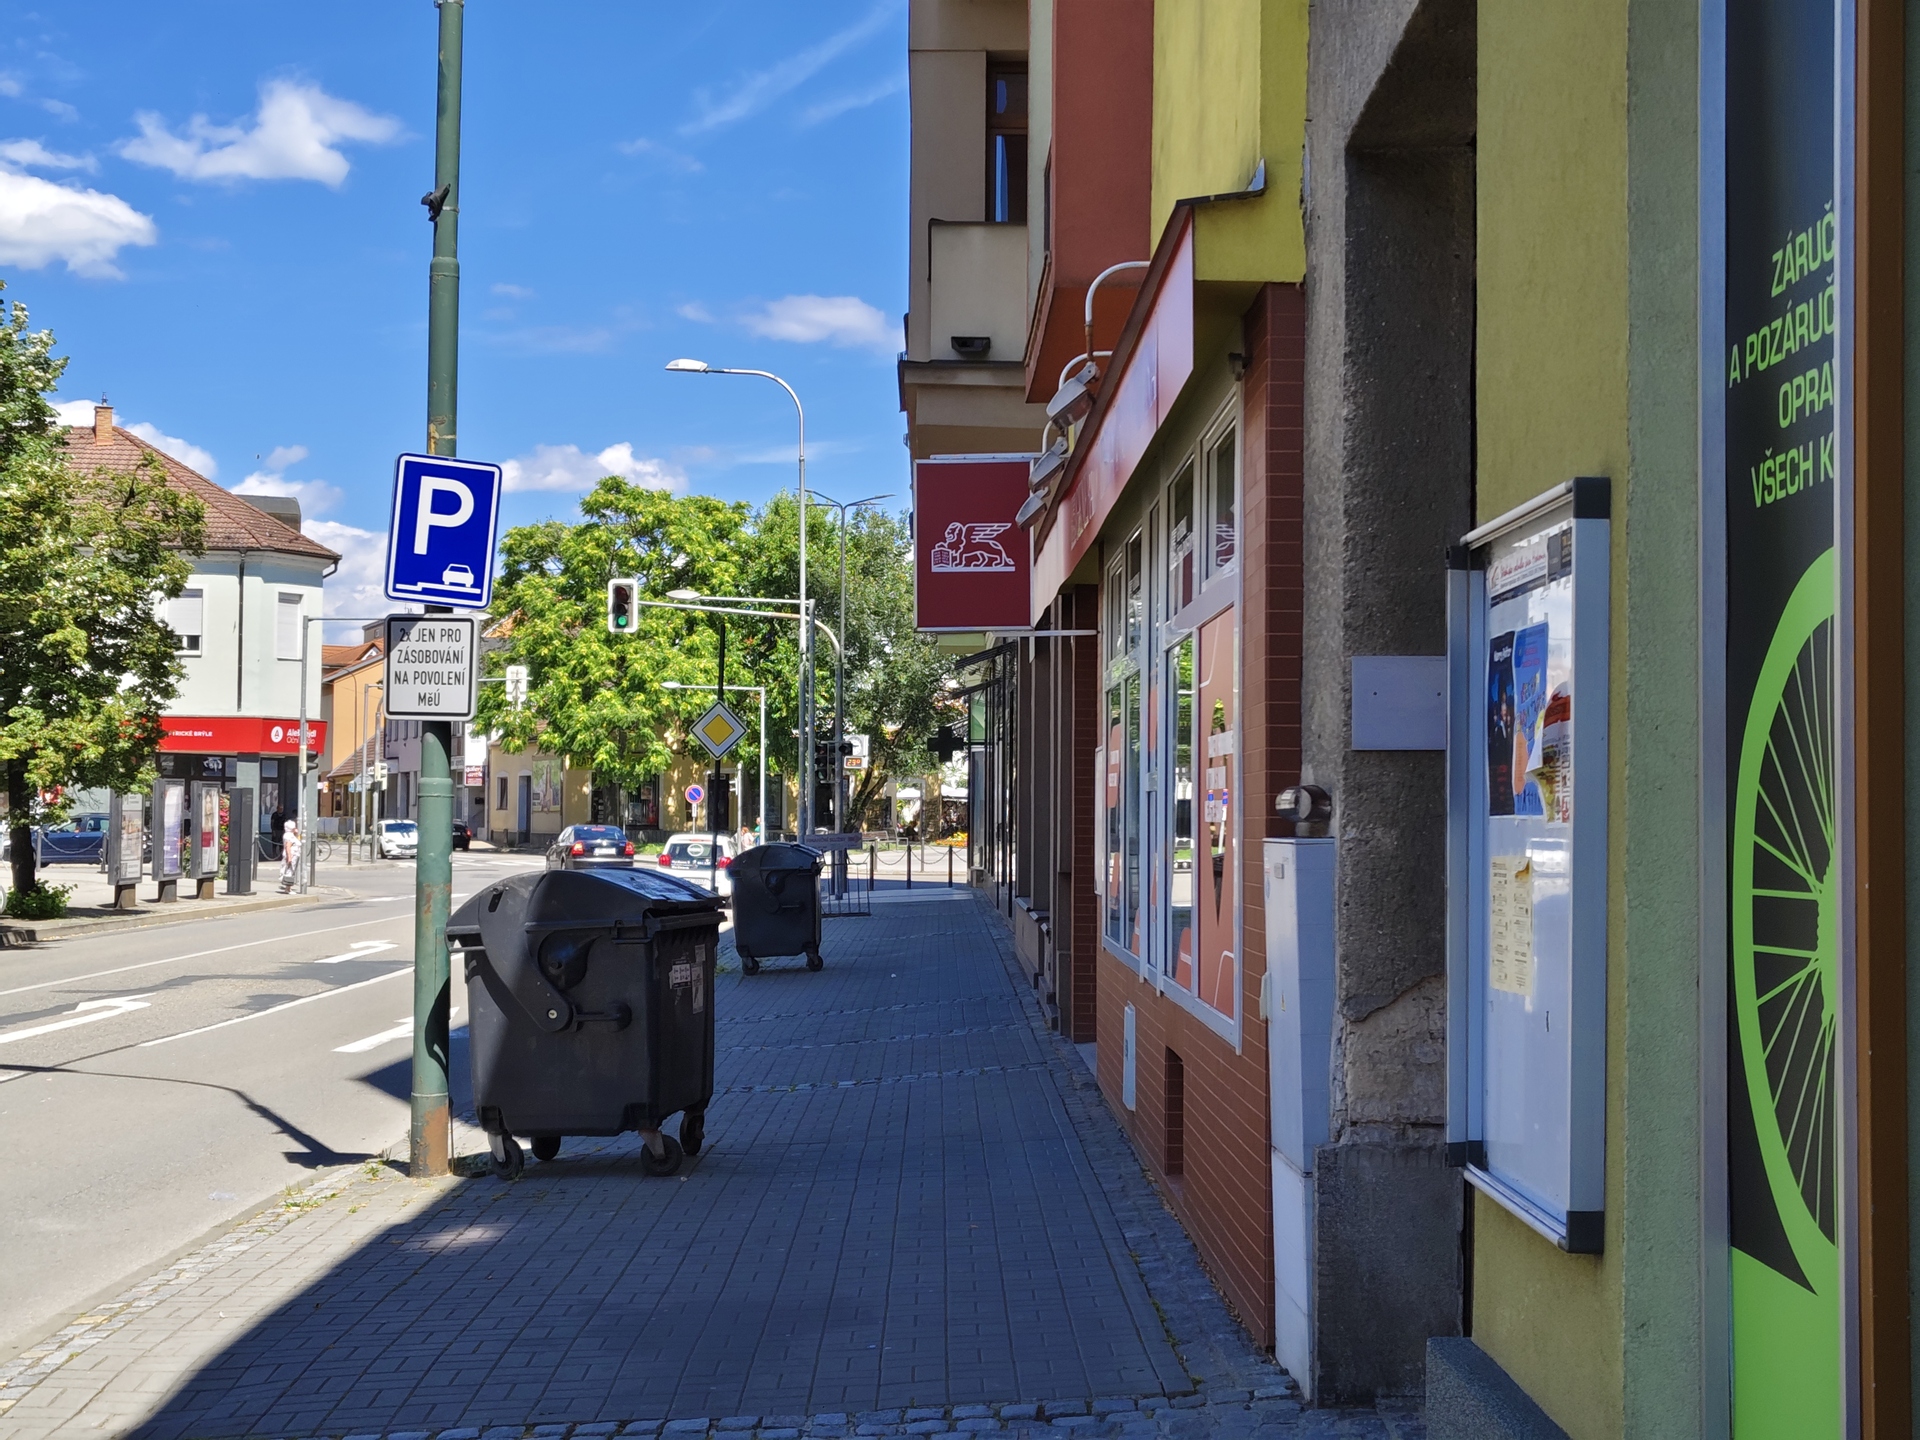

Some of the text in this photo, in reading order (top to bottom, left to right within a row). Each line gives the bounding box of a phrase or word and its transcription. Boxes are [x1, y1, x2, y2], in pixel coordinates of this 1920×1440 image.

[1771, 199, 1834, 298] ZÁRUČ
[1729, 273, 1835, 389] A POZÁRUČ
[1779, 358, 1834, 429] OPRA
[1751, 440, 1813, 509] VŠECH
[413, 475, 475, 556] P
[397, 645, 465, 664] ZÁSOBOVÁNÍ
[415, 628, 435, 643] JEN
[440, 628, 461, 643] PRO
[394, 667, 466, 686] NA POVOLENÍ
[417, 688, 440, 707] MěÚ
